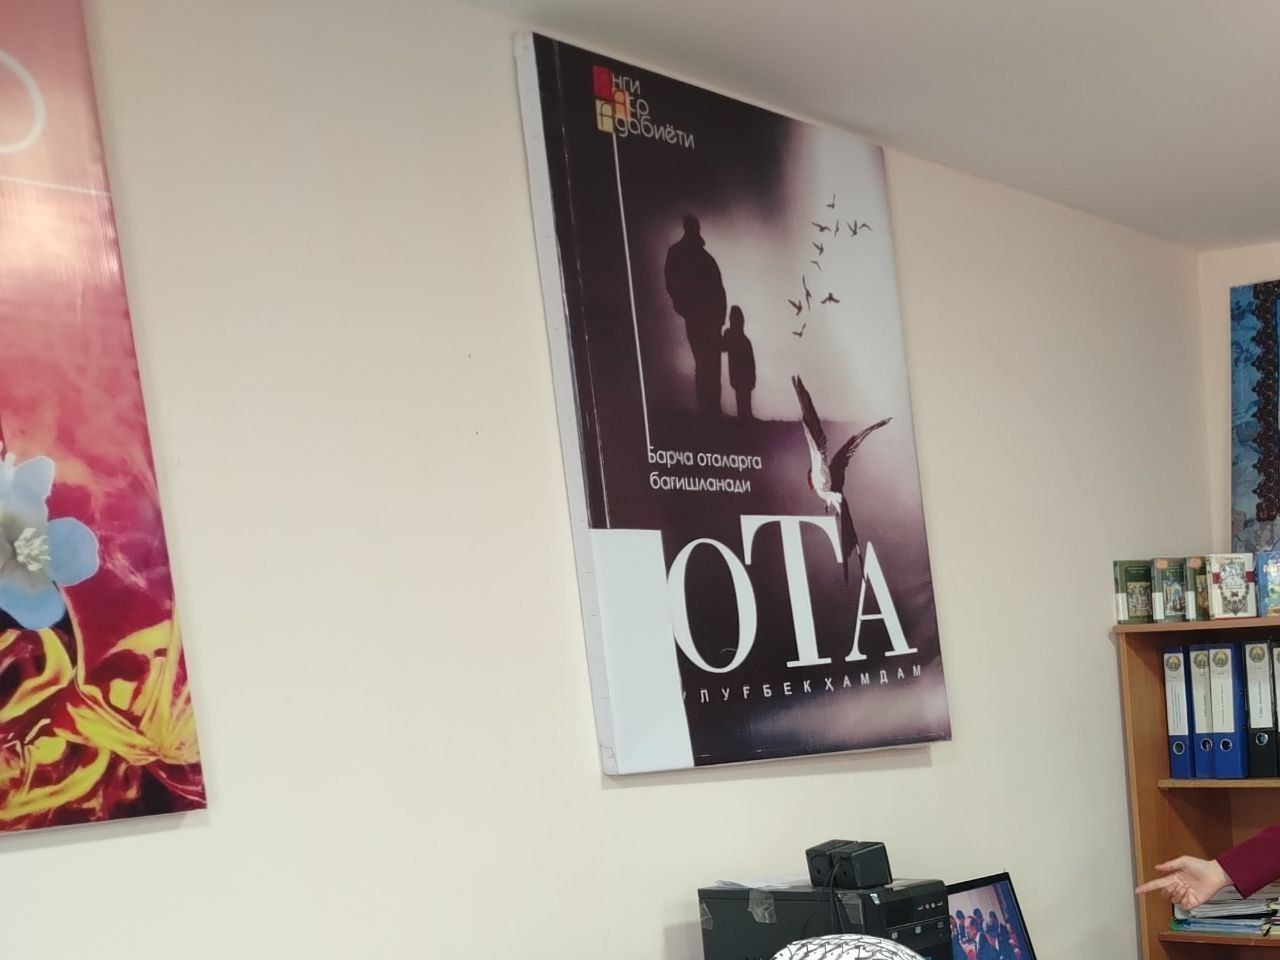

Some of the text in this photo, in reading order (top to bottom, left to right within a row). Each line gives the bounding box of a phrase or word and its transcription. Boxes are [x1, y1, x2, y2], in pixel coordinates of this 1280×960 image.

[648, 446, 762, 472] Барча оталарга
[667, 515, 919, 674] ОТА
[682, 680, 813, 704] ЛУҒБЕК
